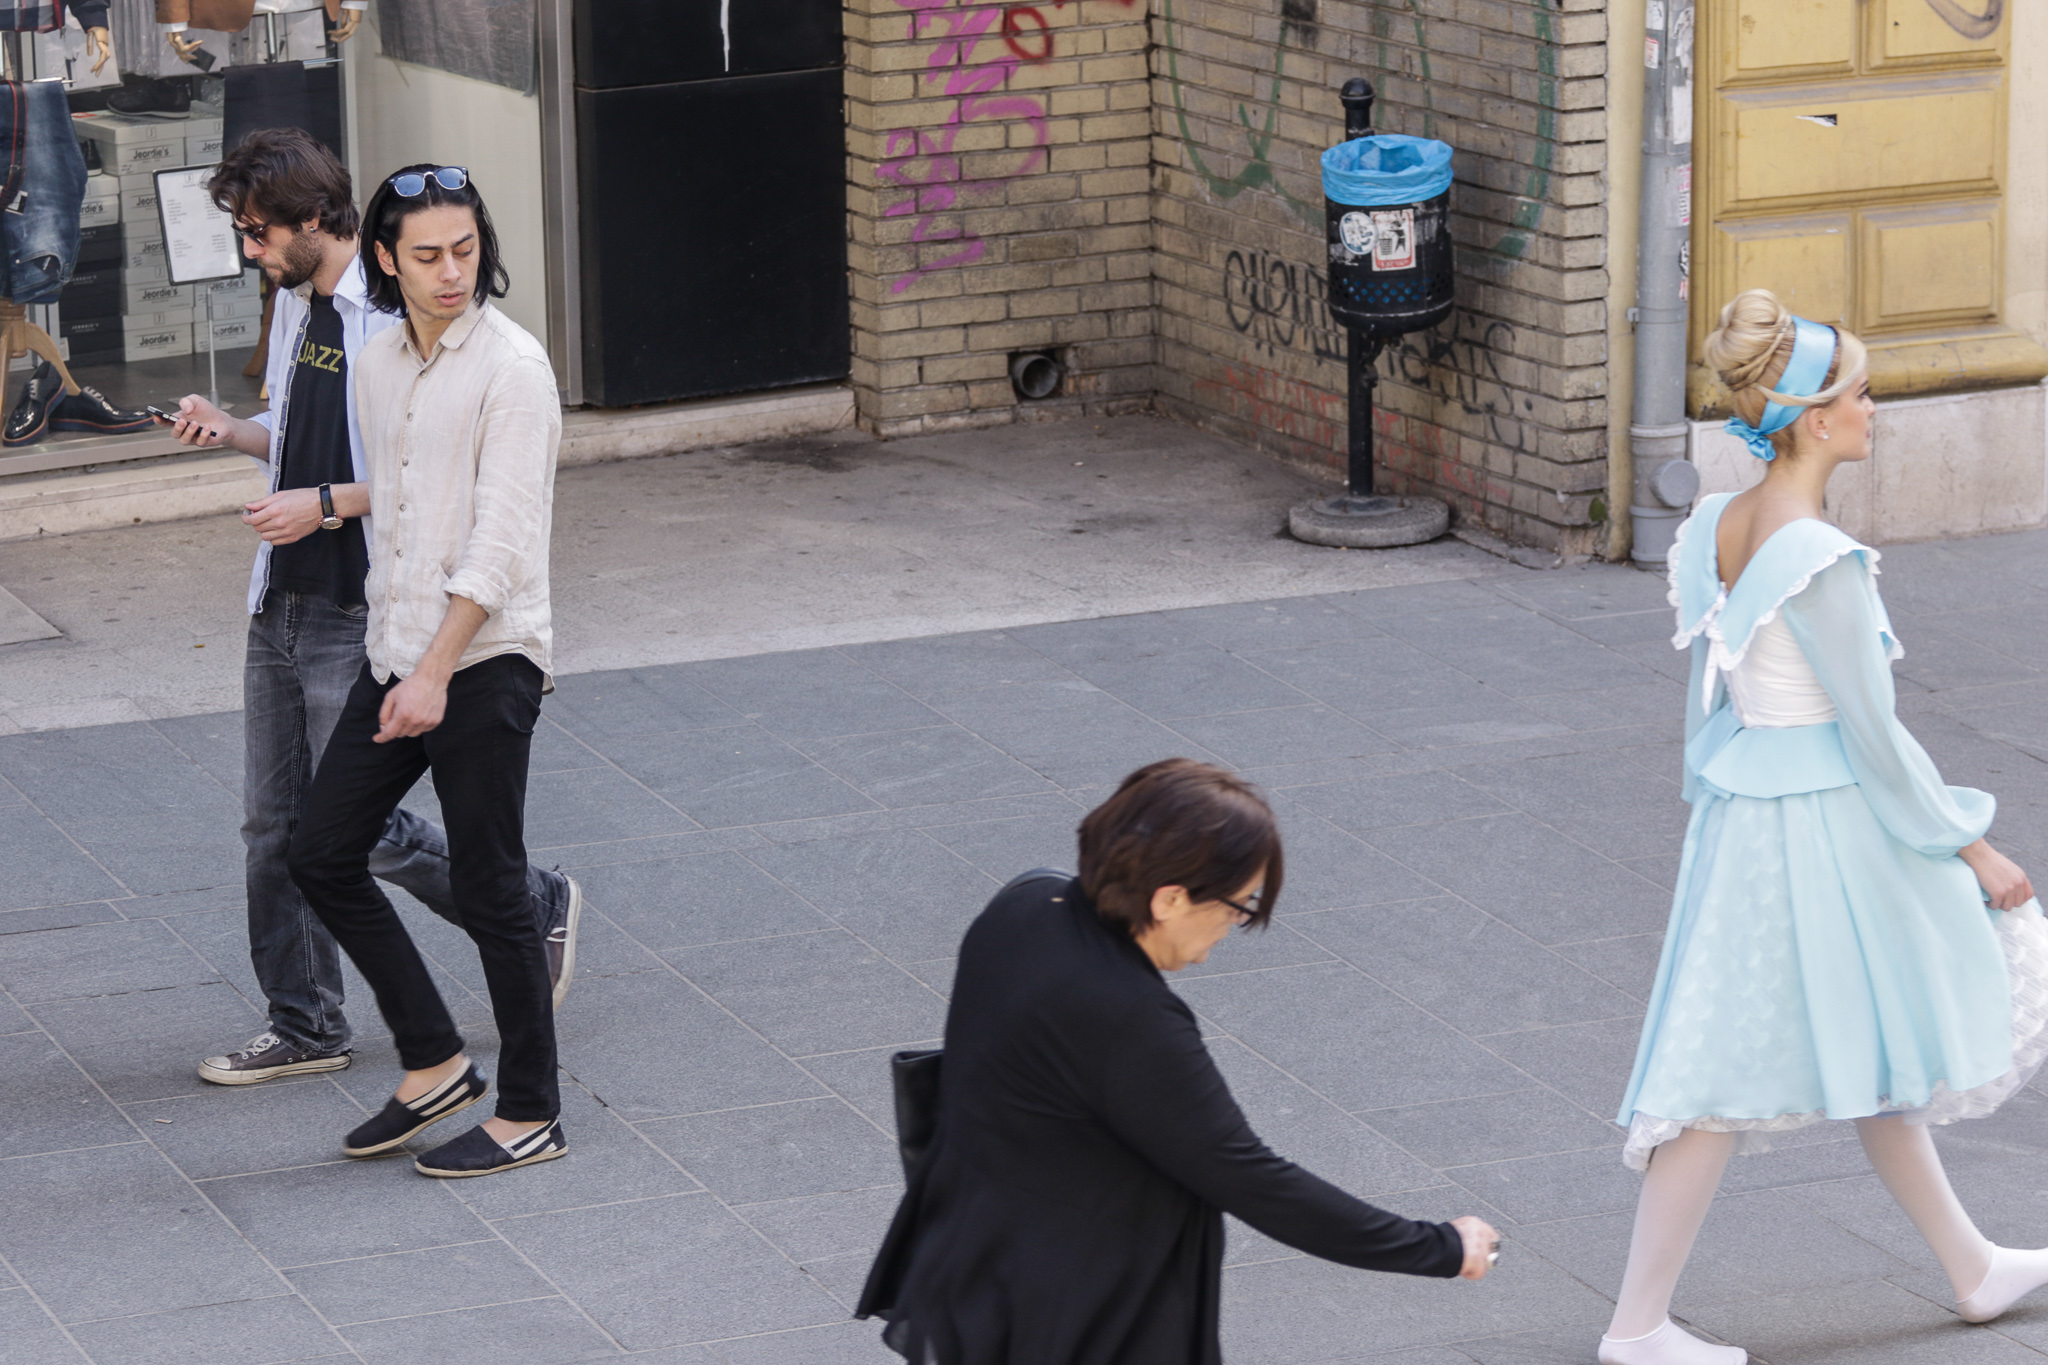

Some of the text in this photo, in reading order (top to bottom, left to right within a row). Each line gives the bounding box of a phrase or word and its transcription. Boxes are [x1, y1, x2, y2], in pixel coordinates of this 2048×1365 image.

[133, 147, 169, 159] Jeordie's
[142, 286, 178, 299] Jeordie's
[139, 333, 176, 346] Jeordie's
[299, 340, 344, 373] JAZZ
